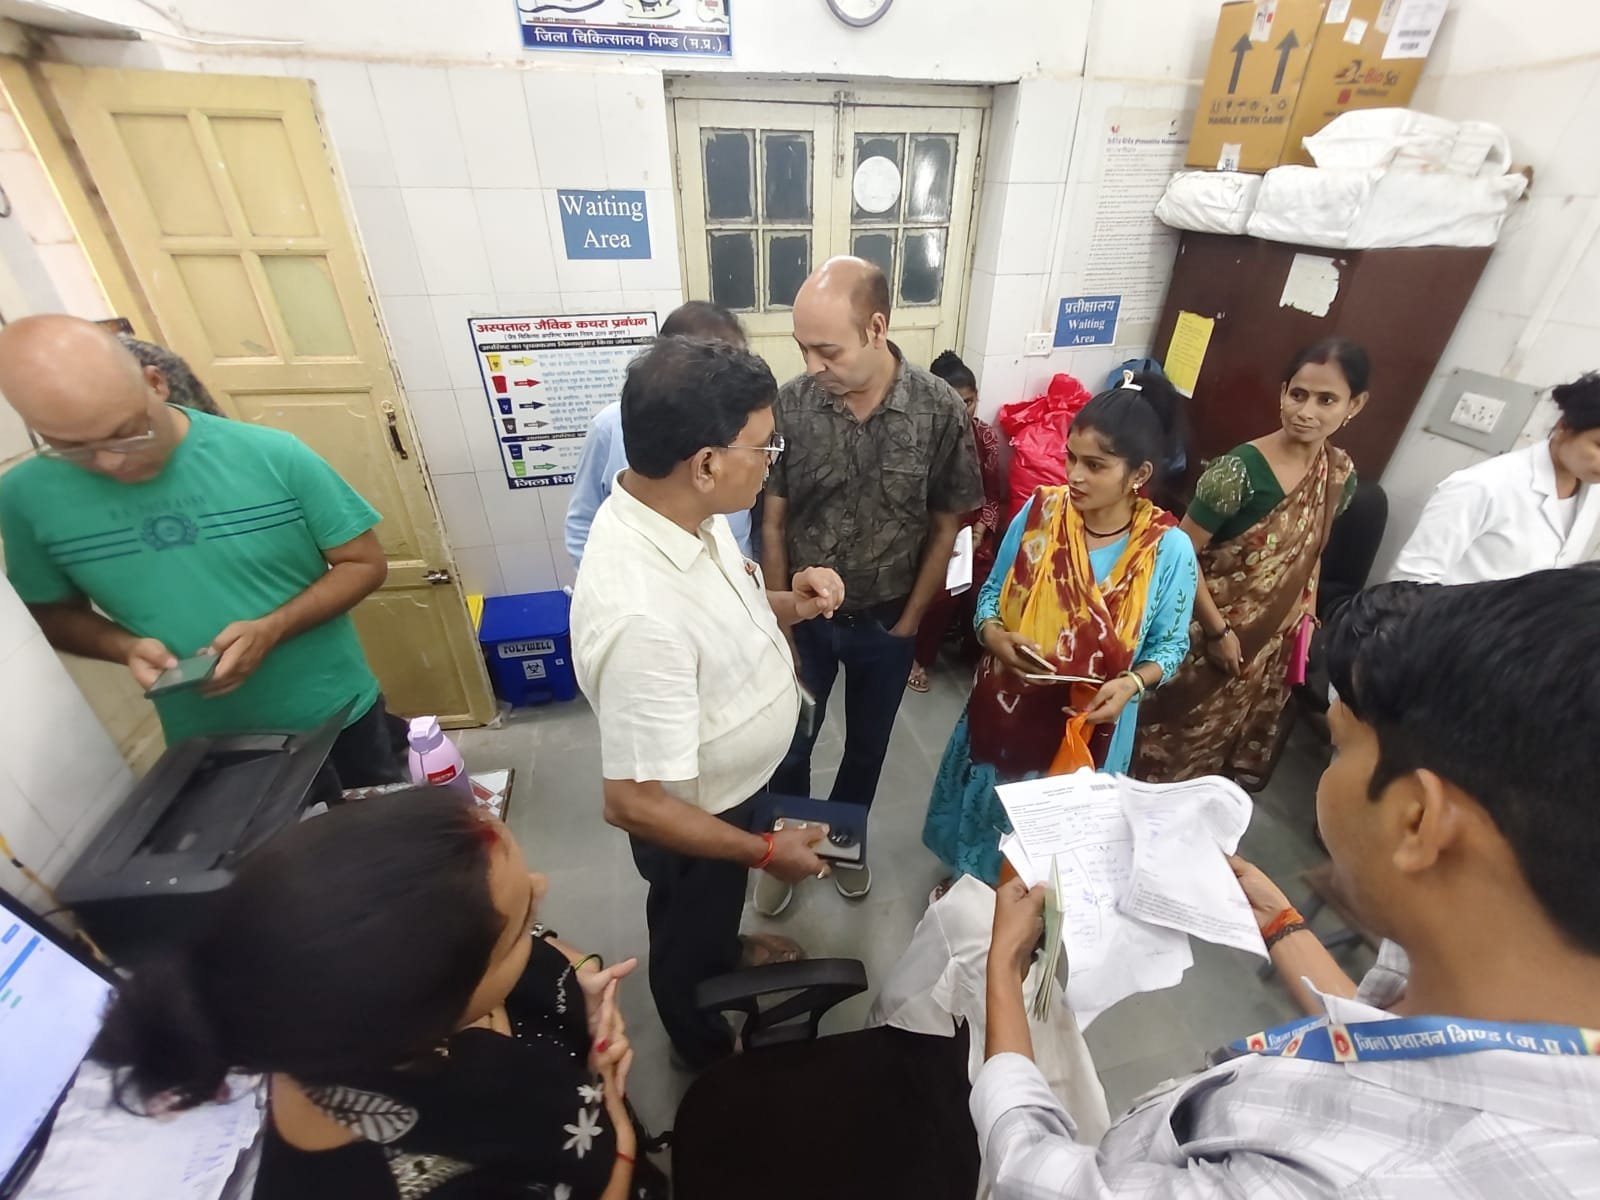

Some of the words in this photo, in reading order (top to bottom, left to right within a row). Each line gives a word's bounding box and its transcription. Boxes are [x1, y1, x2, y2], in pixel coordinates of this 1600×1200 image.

[534, 28, 568, 43] जिला
[573, 29, 645, 47] चिकित्सालय
[648, 32, 679, 48] भिण्ड
[1207, 115, 1238, 125] HANDLE
[1238, 115, 1260, 124] WITH
[1262, 115, 1284, 124] CARE
[560, 194, 644, 221] Waiting
[583, 228, 632, 248] Area
[1065, 298, 1116, 314] प्रतीक्षालय
[476, 321, 531, 333] अस्पताल
[534, 319, 572, 331] जैविक
[576, 319, 608, 330] कचरा
[612, 316, 648, 329] प्रबंधन
[1068, 317, 1106, 330] Waiting
[1071, 334, 1096, 344] Area
[1353, 1031, 1388, 1051] जिला
[1388, 1030, 1445, 1049] प्रशासन
